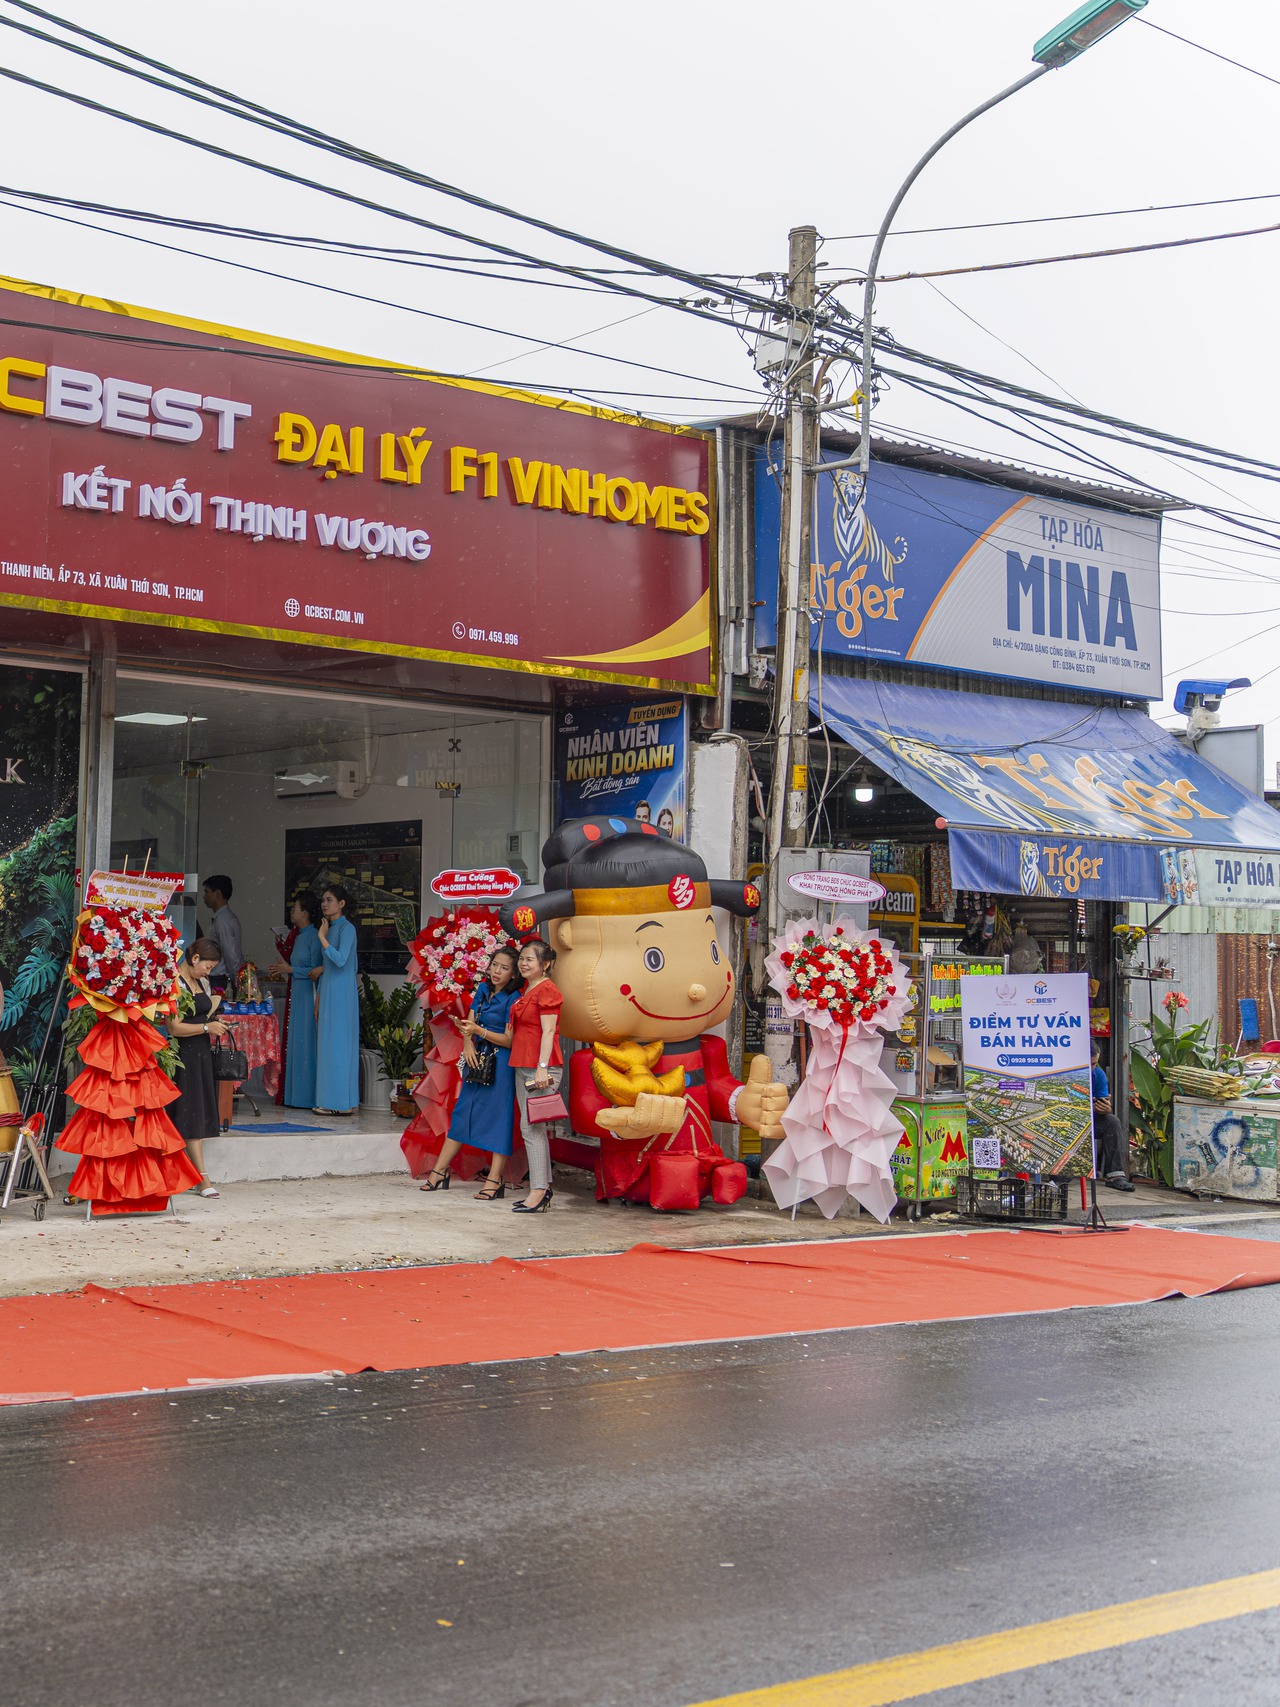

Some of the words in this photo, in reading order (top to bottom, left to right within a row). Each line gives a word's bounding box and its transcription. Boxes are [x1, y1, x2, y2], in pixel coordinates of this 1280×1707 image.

[274, 411, 365, 480] ĐẠI
[380, 426, 433, 485] LÝ
[450, 446, 499, 499] F1
[507, 457, 710, 536] VINHOMES
[62, 465, 131, 513] KẾT
[139, 478, 202, 525] NỐI
[210, 495, 307, 543] THỊNH
[314, 512, 431, 561] VƯỢNG
[1039, 515, 1068, 551] TẠP
[1074, 517, 1104, 552] HÓA
[0, 561, 31, 578] THANH
[33, 562, 55, 583] NIÊN,
[58, 562, 70, 583] ẤP
[72, 570, 86, 586] 73,
[88, 570, 102, 587] XÃ
[104, 573, 127, 591] XUÂN
[130, 576, 150, 594] THỚI
[152, 581, 171, 599] SƠN,
[174, 586, 204, 602] TP.HCM
[809, 560, 904, 639] Tiger
[304, 604, 364, 625] QCBEST.COM.VN
[1006, 549, 1138, 652] MINA
[469, 627, 519, 645] 0971.459.996
[633, 705, 655, 720] TUYỂN
[657, 704, 677, 718] DỤNG
[567, 729, 615, 759] NHÂN
[619, 721, 660, 749] VIÊN
[566, 753, 608, 782] KINH
[611, 743, 675, 775] DOANH
[579, 776, 602, 800] Bất
[602, 775, 623, 794] động
[624, 773, 640, 786] sản
[970, 753, 1229, 840] Tiger
[799, 881, 813, 889] KHAI
[803, 873, 815, 881] SONG
[816, 875, 831, 883] TRANG
[1043, 843, 1104, 893] Tiger
[1215, 859, 1242, 893] TẠP
[1246, 856, 1275, 887] HÓA
[969, 1011, 1011, 1029] ĐIỂM
[1016, 1013, 1040, 1028] TƯ
[1044, 1011, 1081, 1028] VẤN
[980, 1032, 1016, 1048] BÁN
[1021, 1031, 1071, 1048] HÀNG
